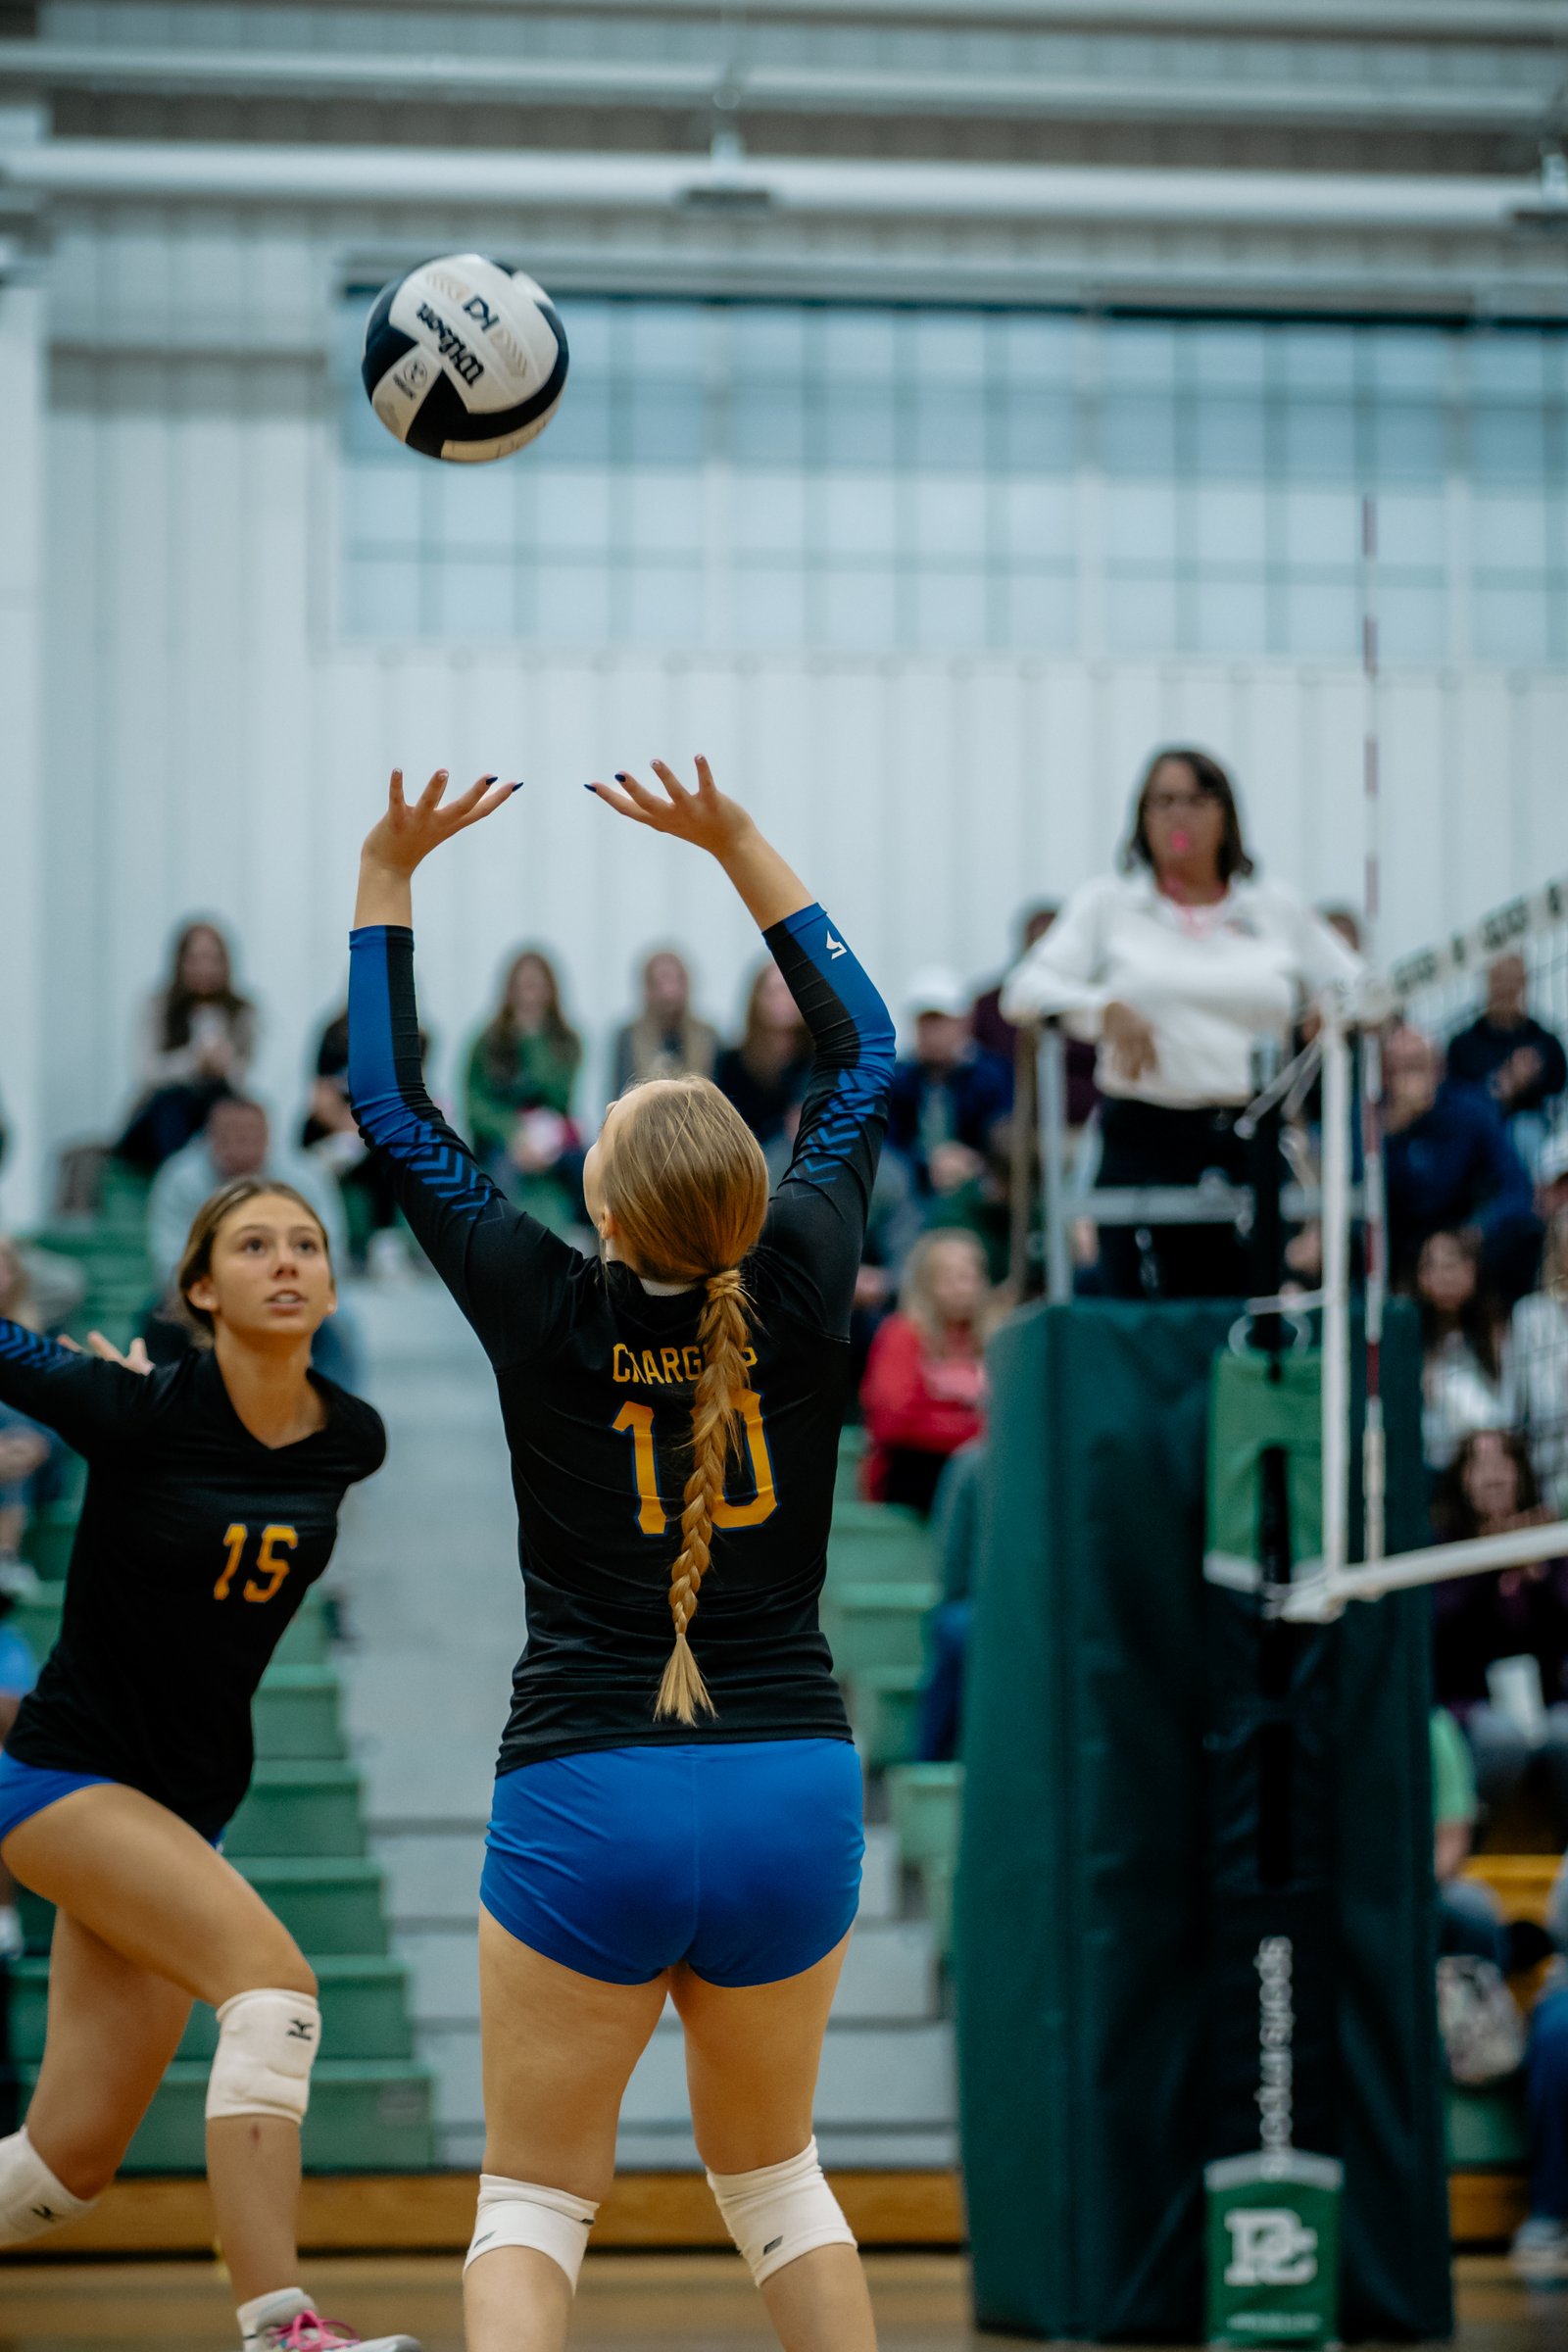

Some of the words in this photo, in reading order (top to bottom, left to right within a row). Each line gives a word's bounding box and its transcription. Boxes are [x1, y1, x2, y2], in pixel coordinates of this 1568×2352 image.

[417, 301, 484, 387] Wilson
[611, 1389, 779, 1537] 10
[214, 1523, 298, 1602] 15
